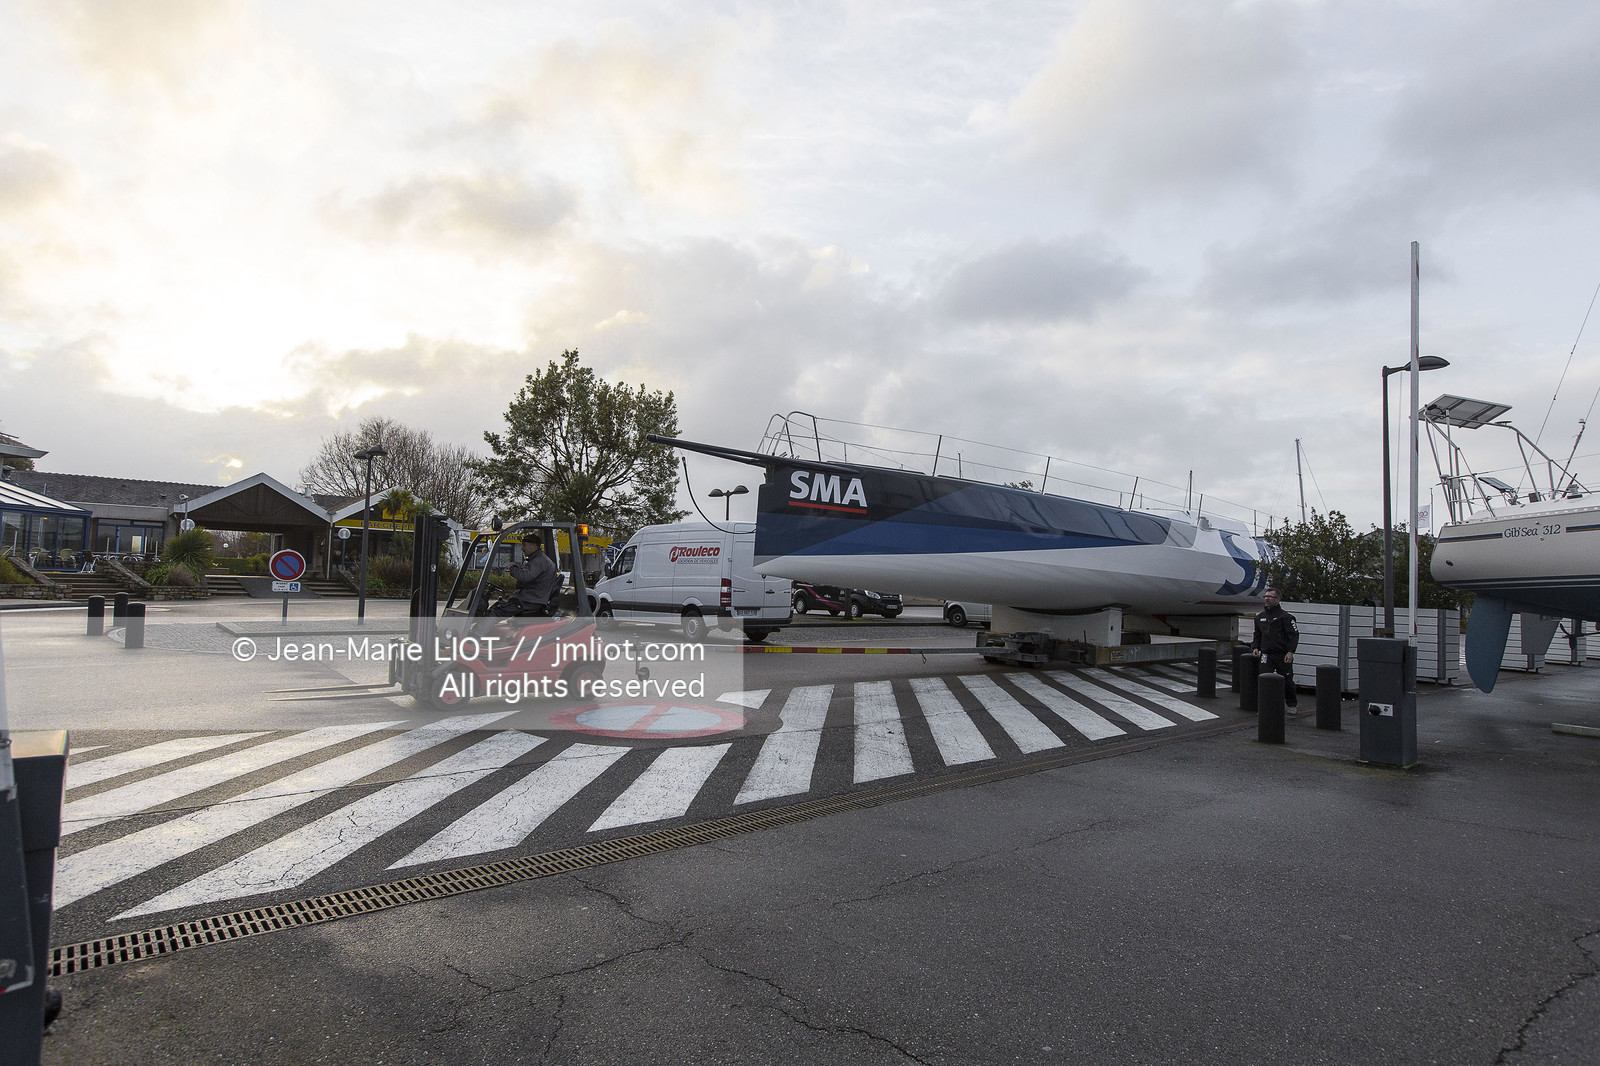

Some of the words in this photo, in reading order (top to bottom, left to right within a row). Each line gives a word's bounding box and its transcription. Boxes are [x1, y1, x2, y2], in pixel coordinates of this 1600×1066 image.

[789, 470, 868, 508] SMA
[1504, 527, 1538, 538] Gib'Sea
[1542, 524, 1561, 535] 312
[678, 546, 720, 557] Rouleco
